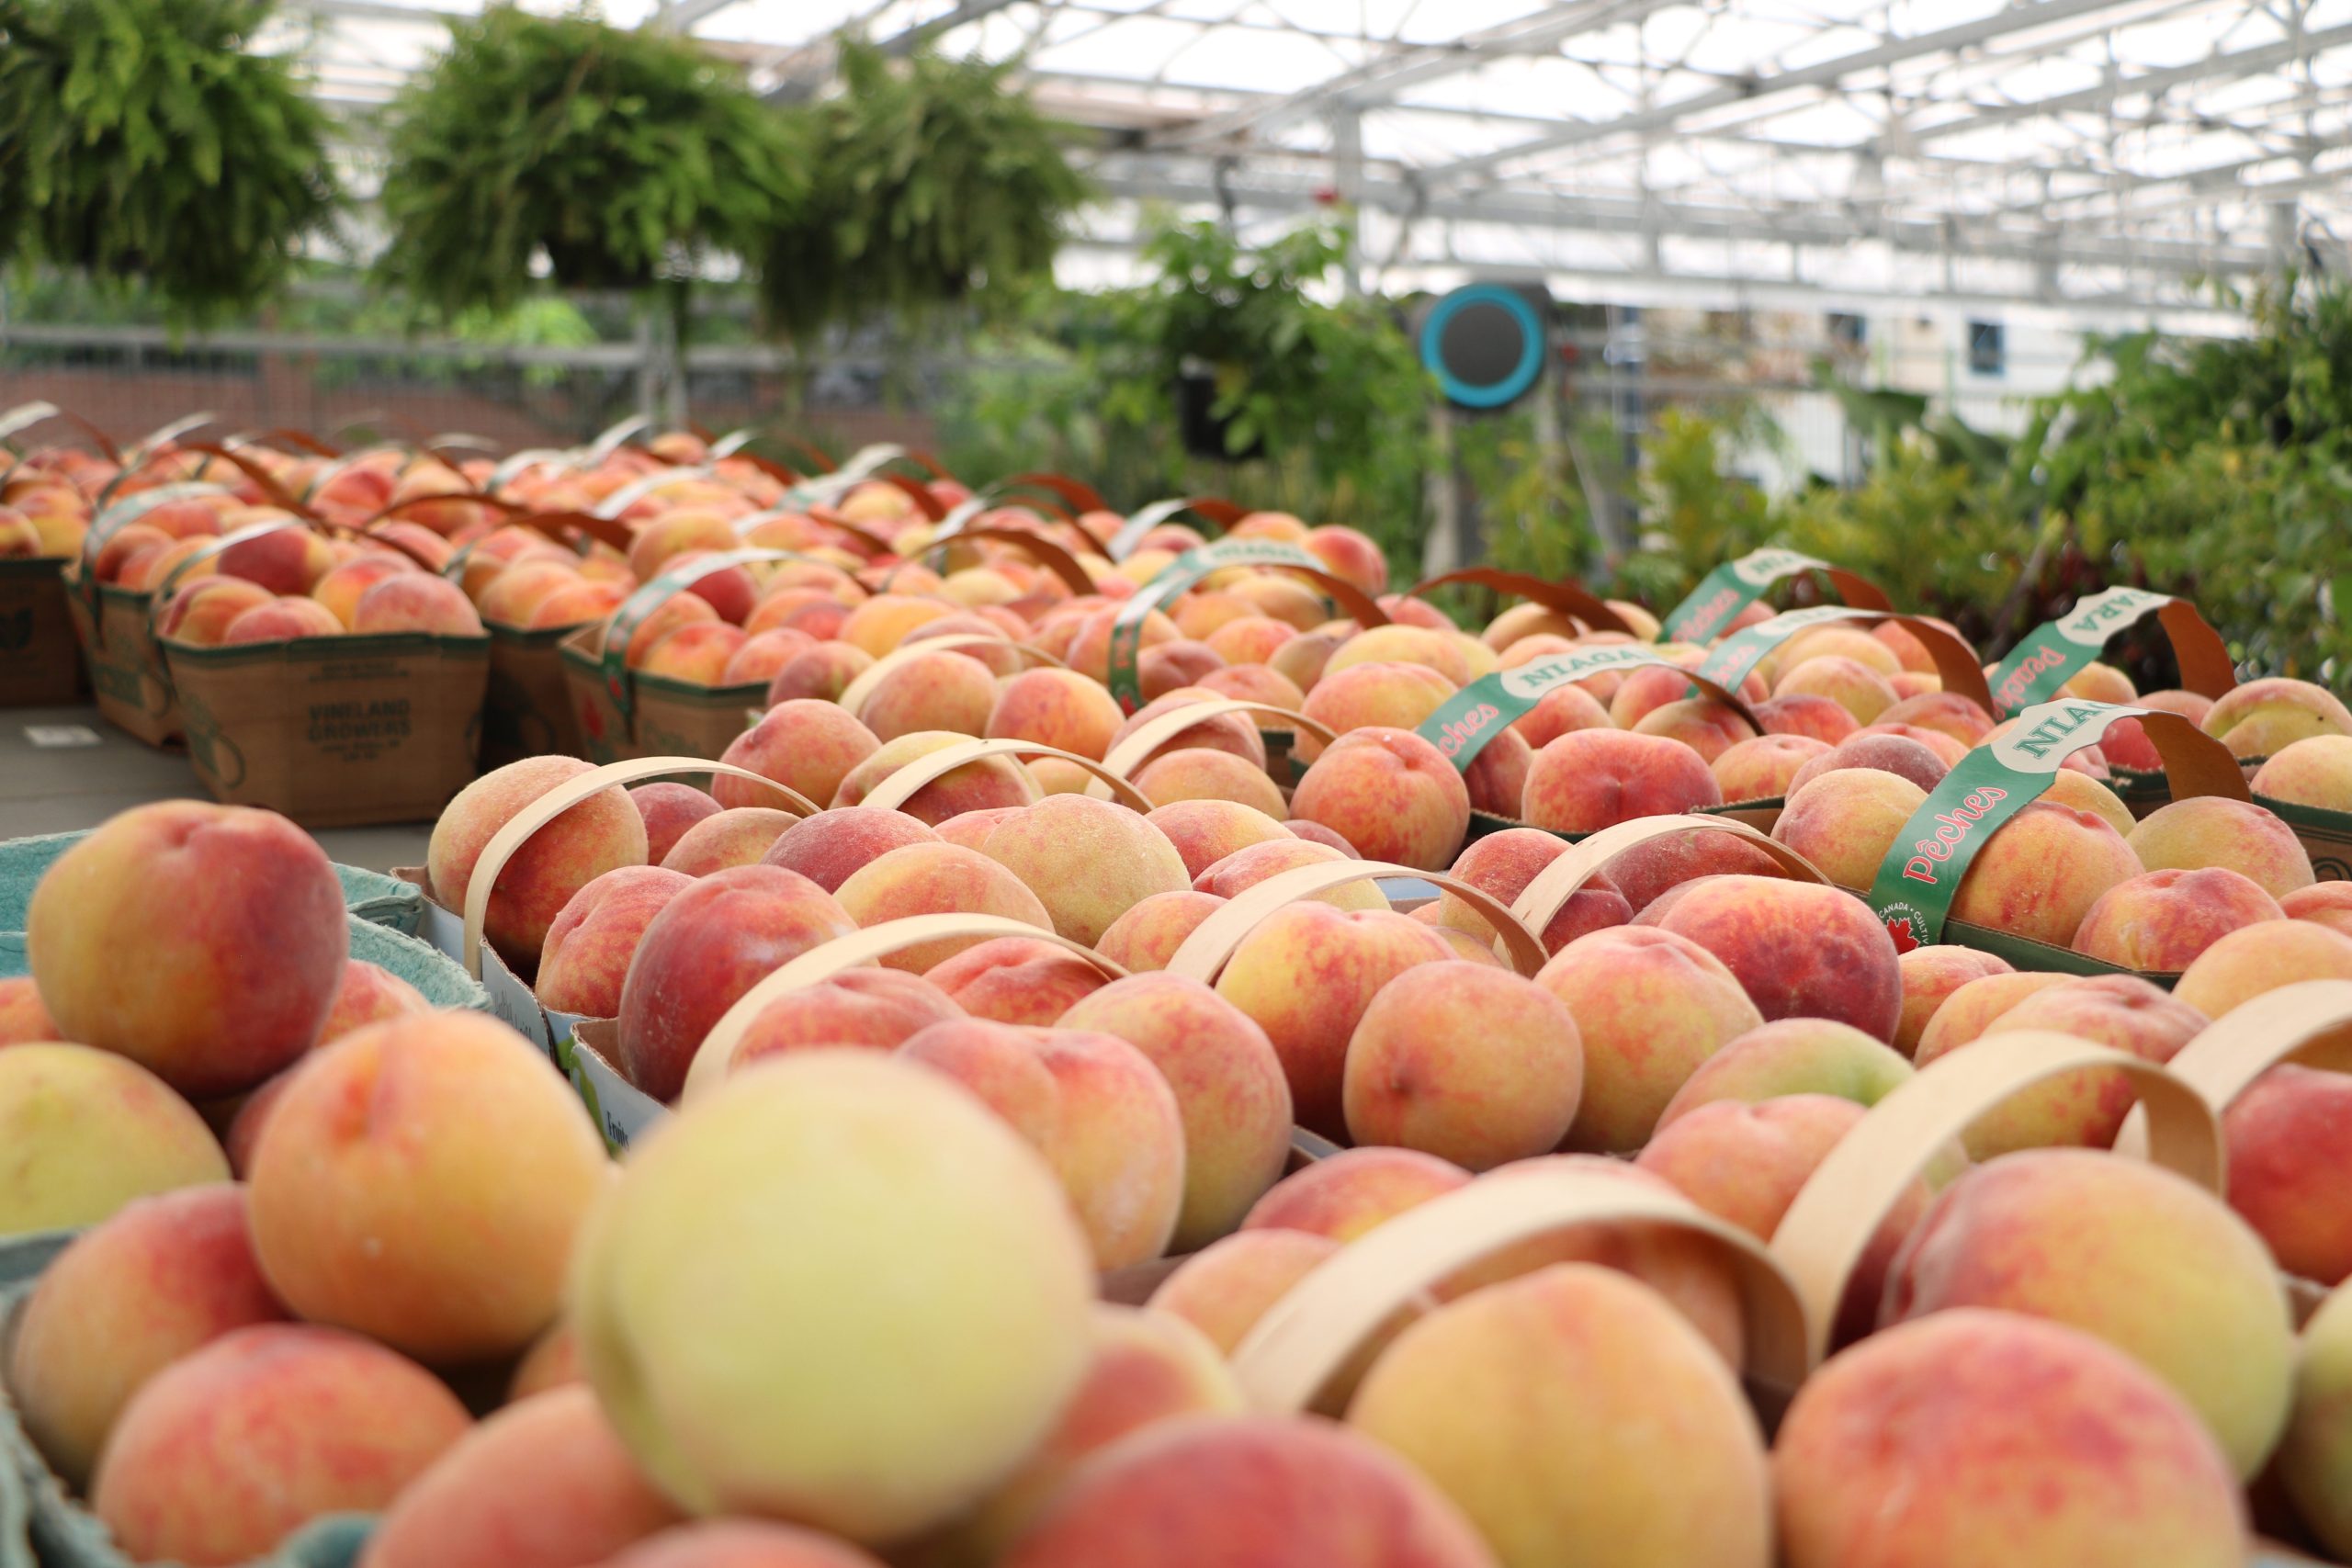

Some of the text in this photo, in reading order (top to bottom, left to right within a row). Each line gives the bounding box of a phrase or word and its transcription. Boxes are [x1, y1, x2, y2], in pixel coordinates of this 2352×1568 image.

[1519, 647, 1654, 687] NIAGA
[1994, 645, 2066, 721] Peache
[308, 718, 412, 742] GROWERS
[309, 699, 411, 719] VINELAND
[1439, 702, 1500, 758] ches
[1902, 786, 2008, 885] Pêches
[1878, 901, 1929, 947] CANADA CULTIV
